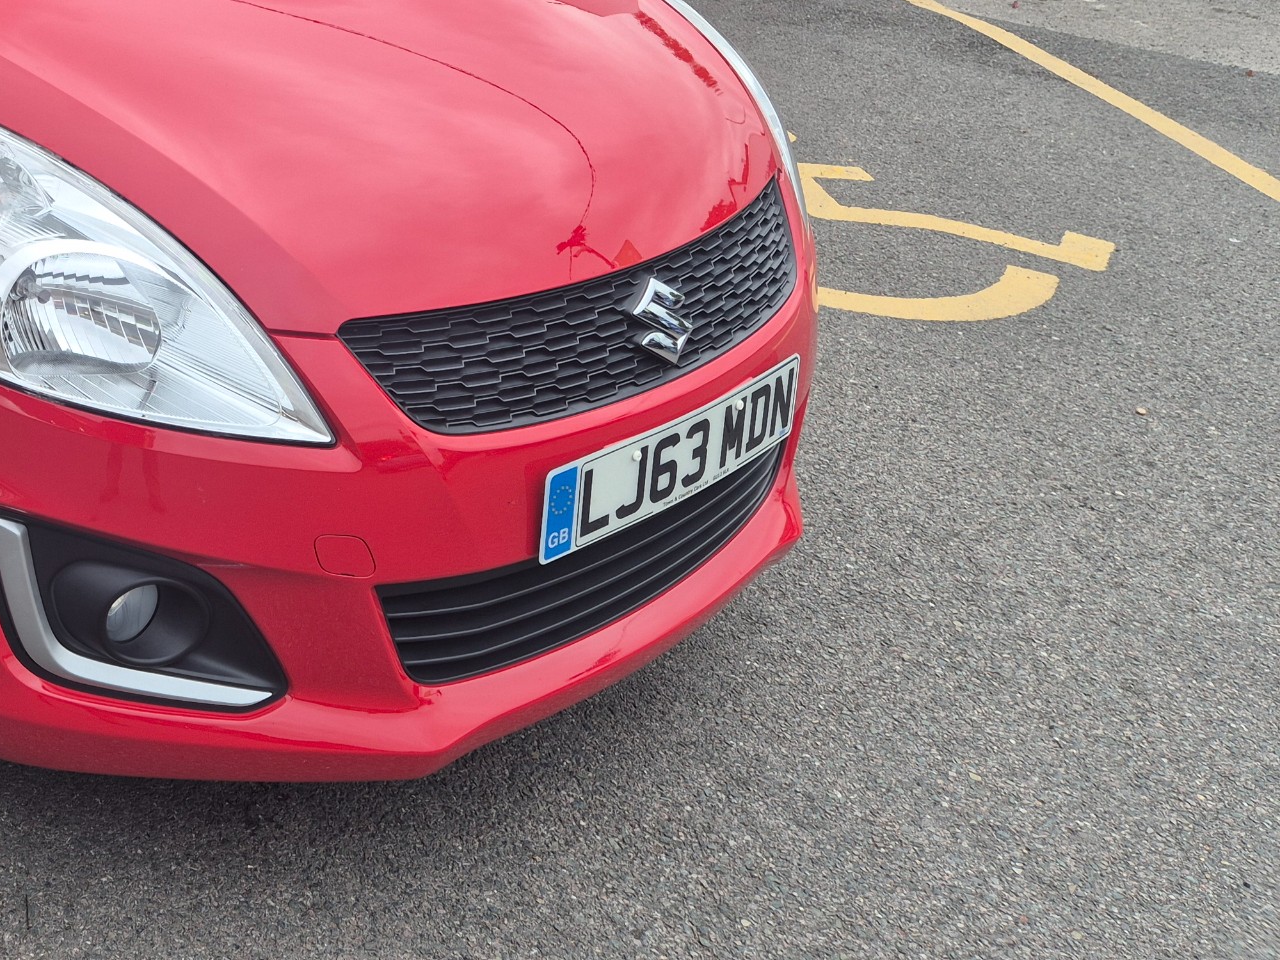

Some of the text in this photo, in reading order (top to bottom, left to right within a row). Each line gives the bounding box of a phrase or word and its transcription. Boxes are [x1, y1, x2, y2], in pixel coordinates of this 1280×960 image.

[579, 367, 795, 538] LJ63 MDN
[548, 527, 569, 549] GB
